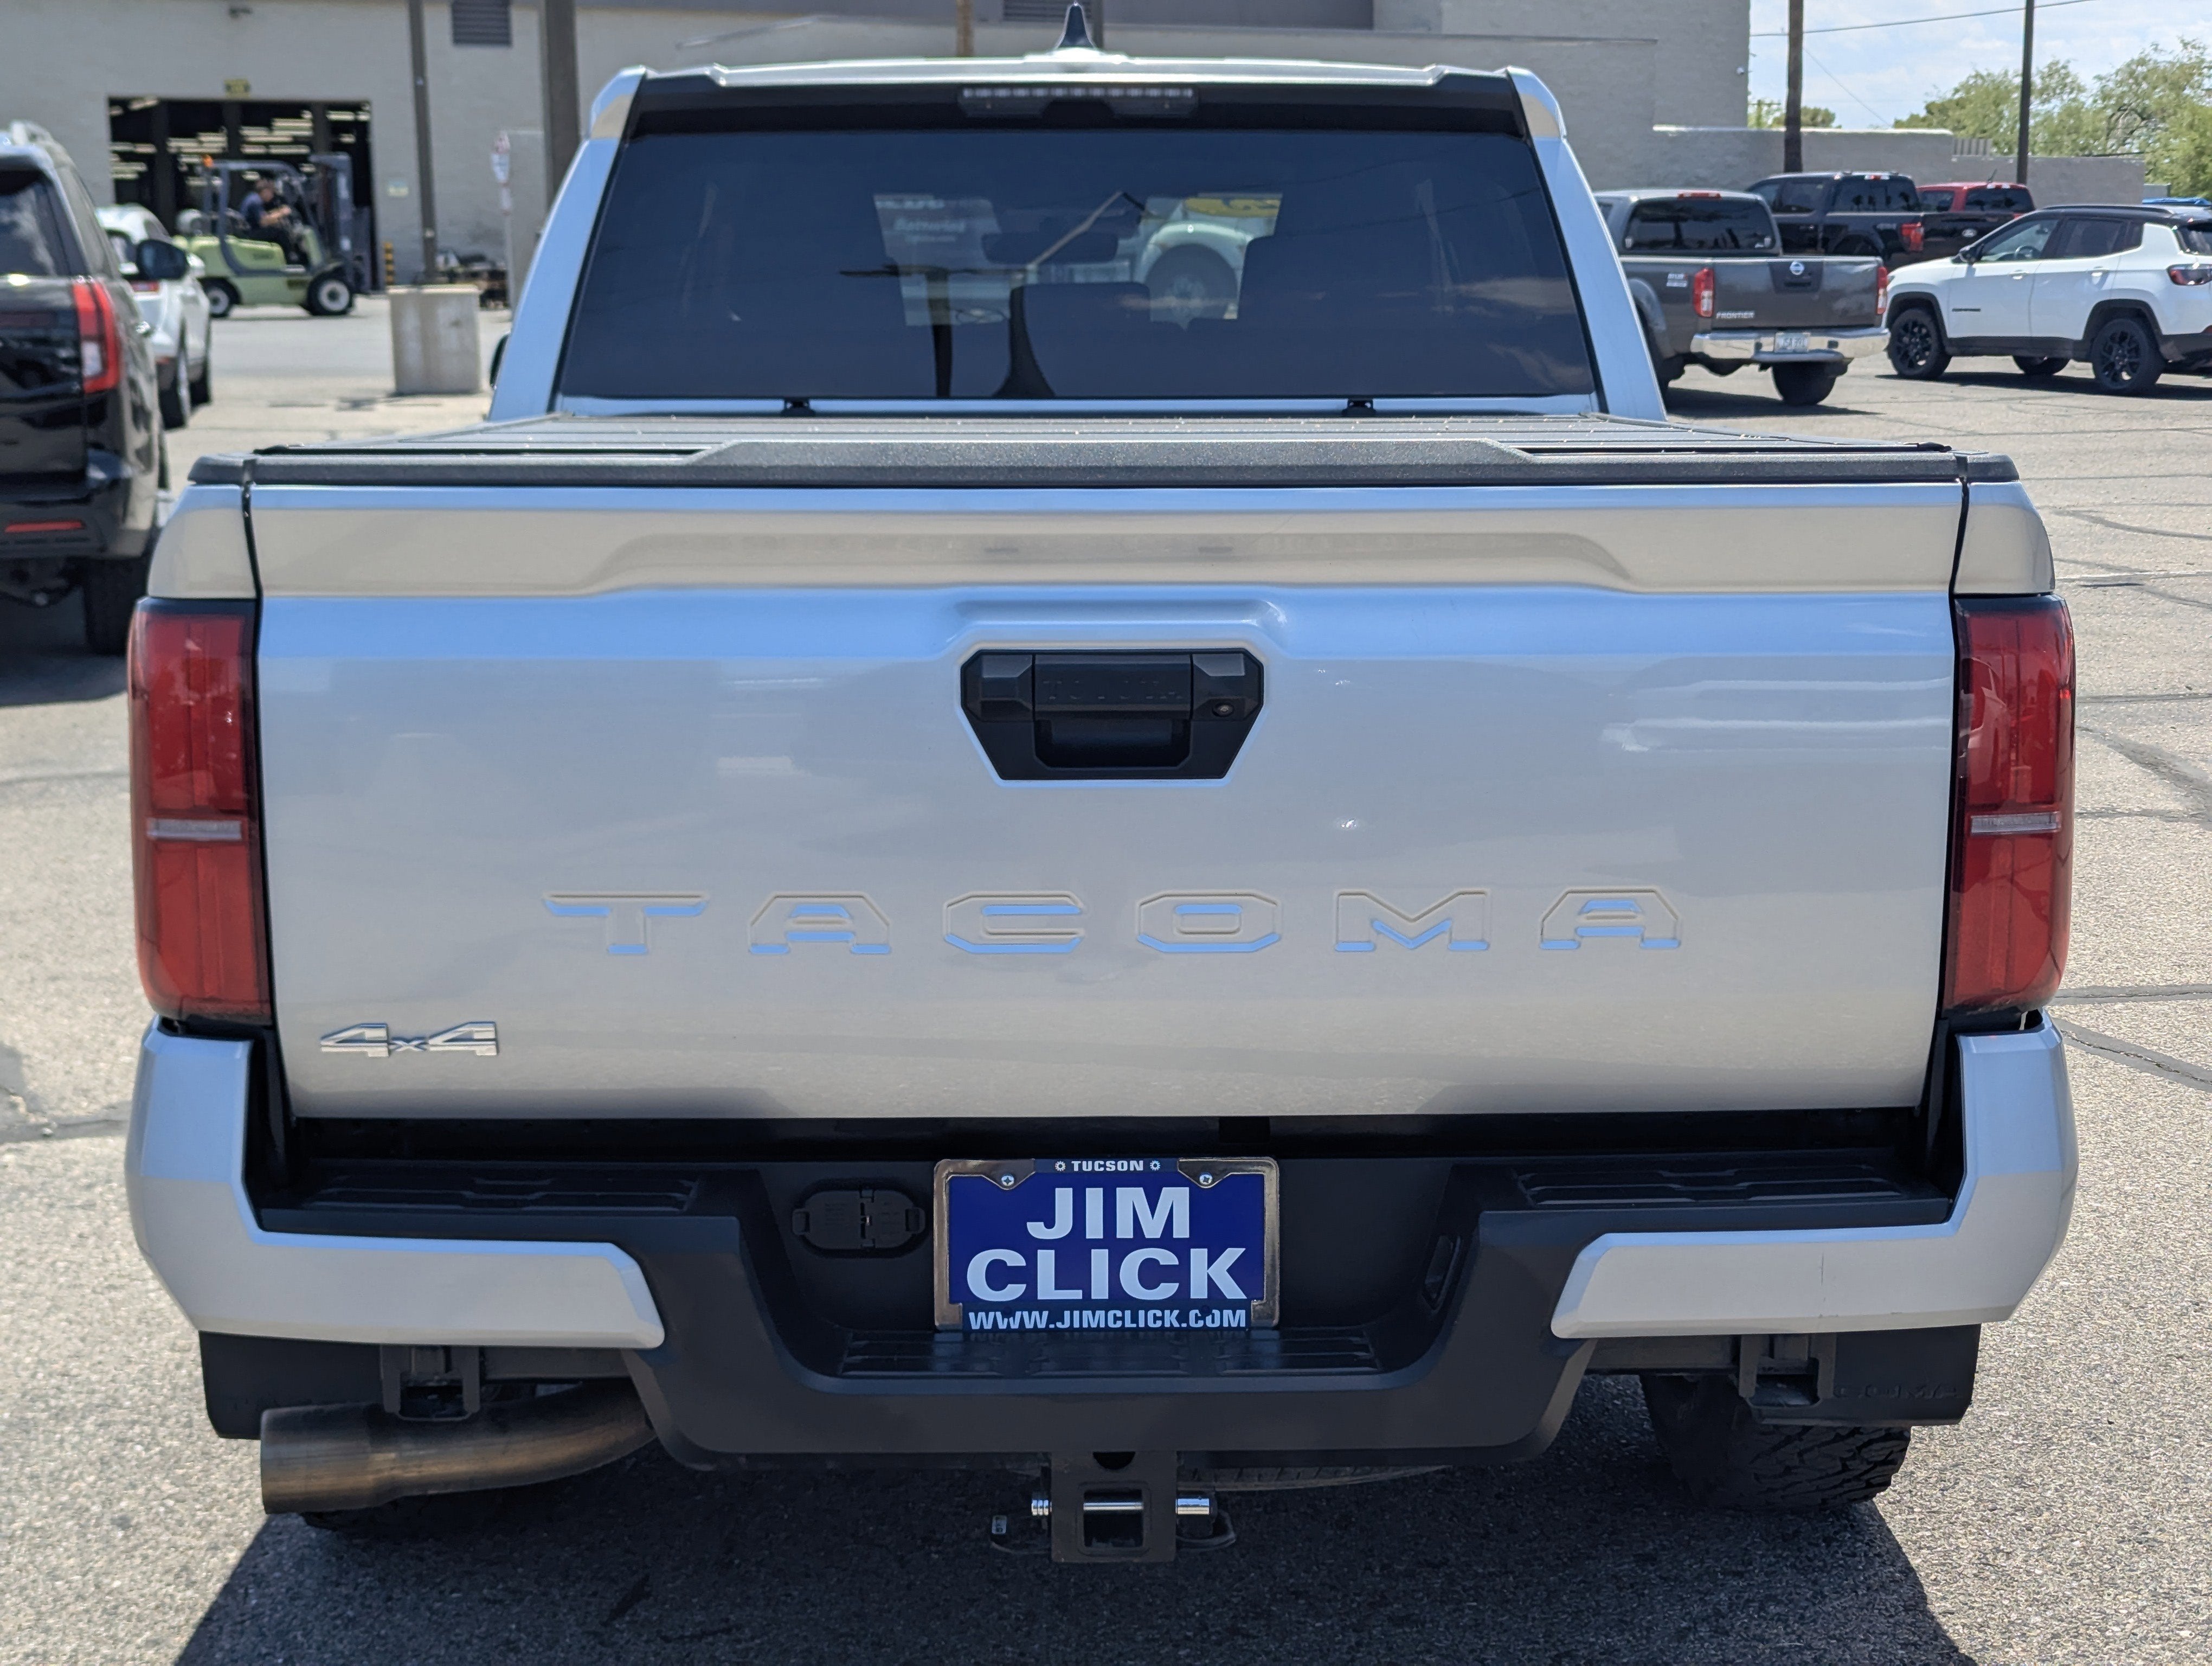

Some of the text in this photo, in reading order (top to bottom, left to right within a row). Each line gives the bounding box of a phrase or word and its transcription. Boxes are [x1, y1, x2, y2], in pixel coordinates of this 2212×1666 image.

[543, 886, 1682, 956] TACOMA
[1071, 1161, 1144, 1171] TUCSON
[1026, 1187, 1189, 1240] JIM
[967, 1247, 1247, 1302] CLICK
[969, 1309, 1246, 1329] WWW.JIMCLICK.COM
